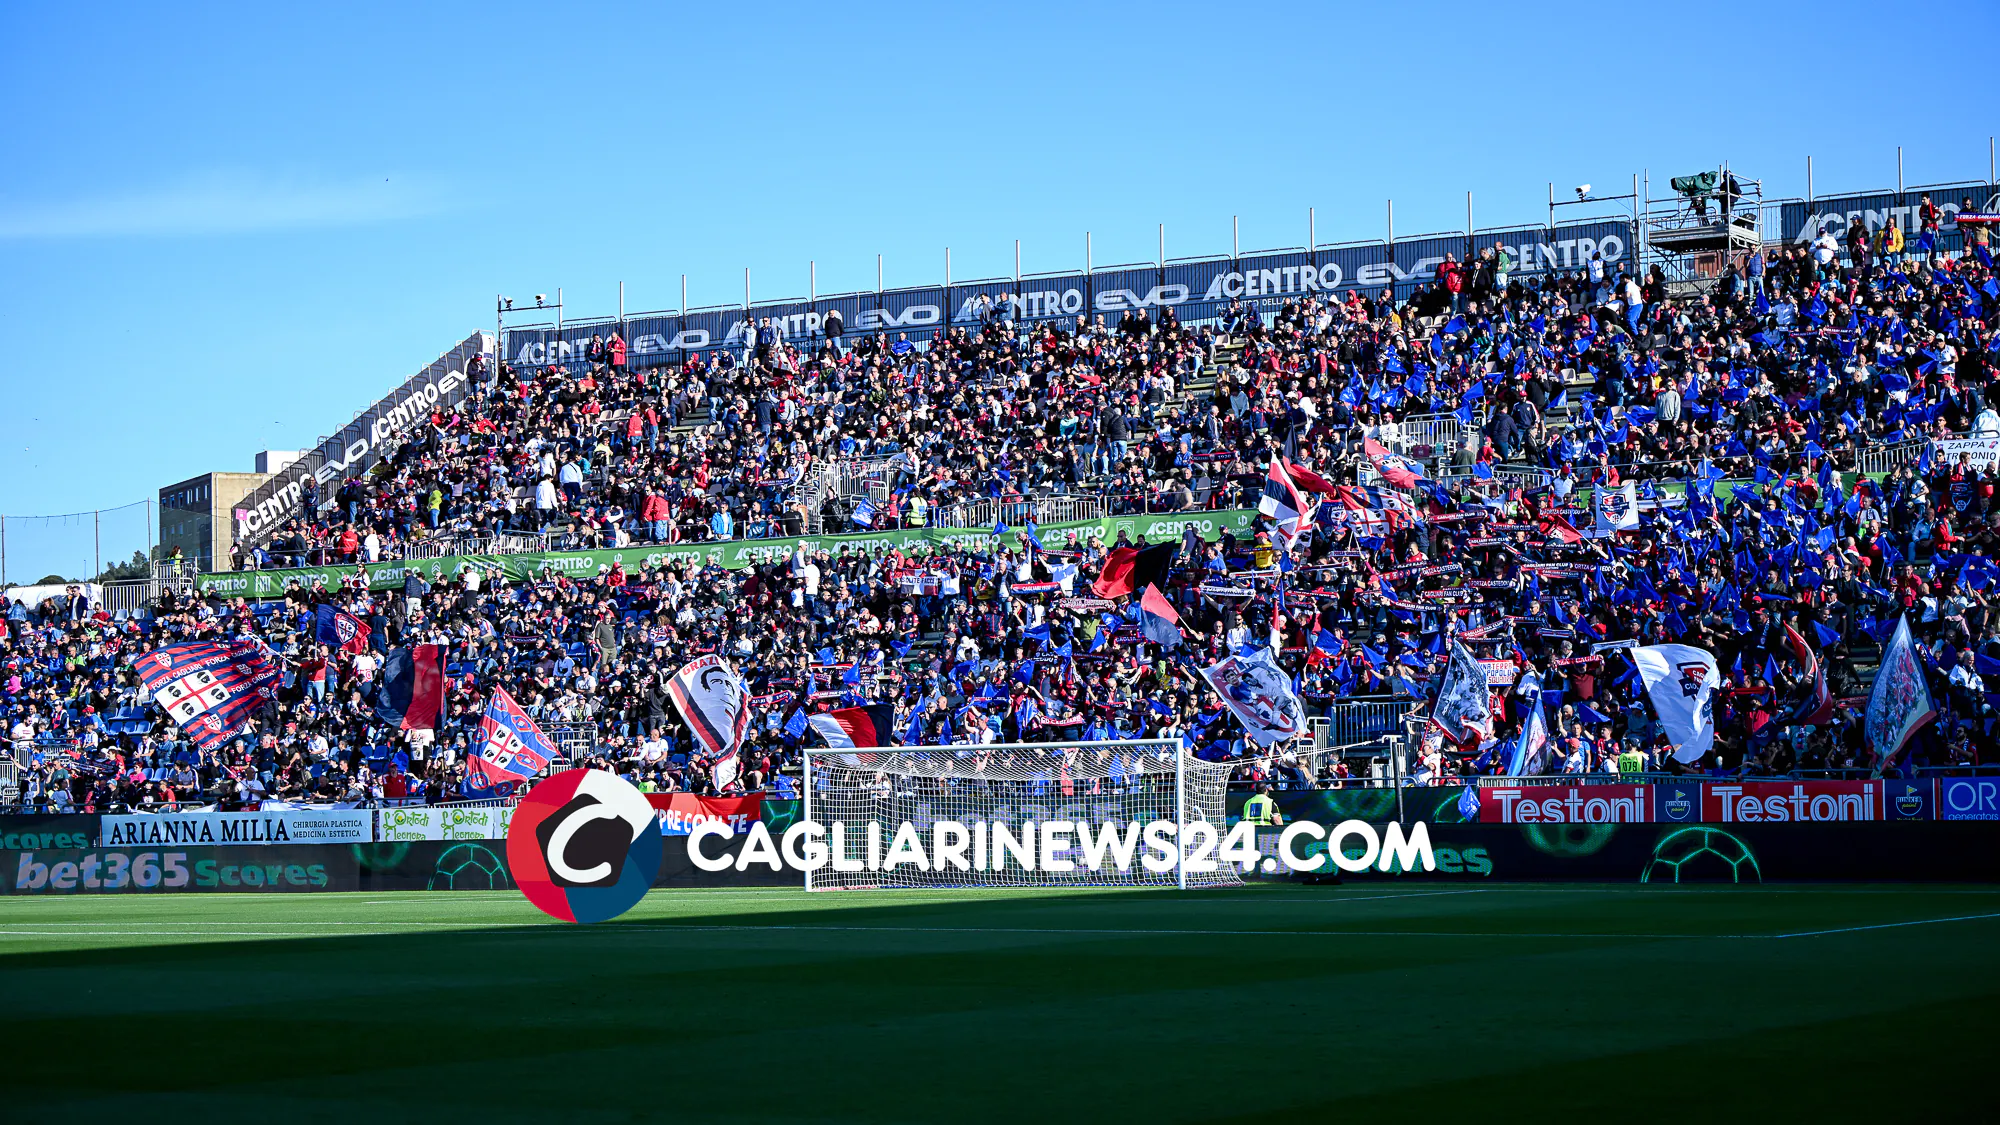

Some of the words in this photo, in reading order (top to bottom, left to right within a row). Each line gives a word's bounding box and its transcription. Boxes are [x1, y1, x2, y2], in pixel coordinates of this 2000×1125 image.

[1488, 235, 1623, 272] CENTRO
[1202, 263, 1342, 300] ACENTRO
[1095, 284, 1189, 311] EVO
[855, 304, 940, 330] EVO
[514, 336, 600, 365] ACENT
[633, 330, 710, 354] EVO
[438, 357, 471, 394] EV
[371, 383, 438, 449] ACENTRO
[1947, 441, 1985, 450] ZAPPA
[316, 438, 369, 485] EVO
[900, 537, 929, 550] Jeep
[1042, 525, 1106, 542] ACENTRO
[537, 557, 594, 570] ACENTRO
[151, 676, 173, 691] FORZA
[172, 663, 203, 679] CAGLIARI
[205, 655, 230, 667] FORZA
[231, 681, 252, 694] FORZA
[1623, 762, 1637, 771] 079
[1493, 787, 1645, 823] Testoni
[1712, 783, 1874, 822] Testoni
[110, 819, 215, 845] ARIANNA
[221, 818, 290, 842] MILIA
[292, 820, 328, 830] CHIRURGIA
[330, 819, 363, 829] PLASTICA
[292, 829, 327, 839] MEDICINA
[329, 828, 361, 838] ESTETICA
[0, 831, 88, 850] cores
[15, 852, 190, 890] bet365
[195, 859, 328, 888] Scores
